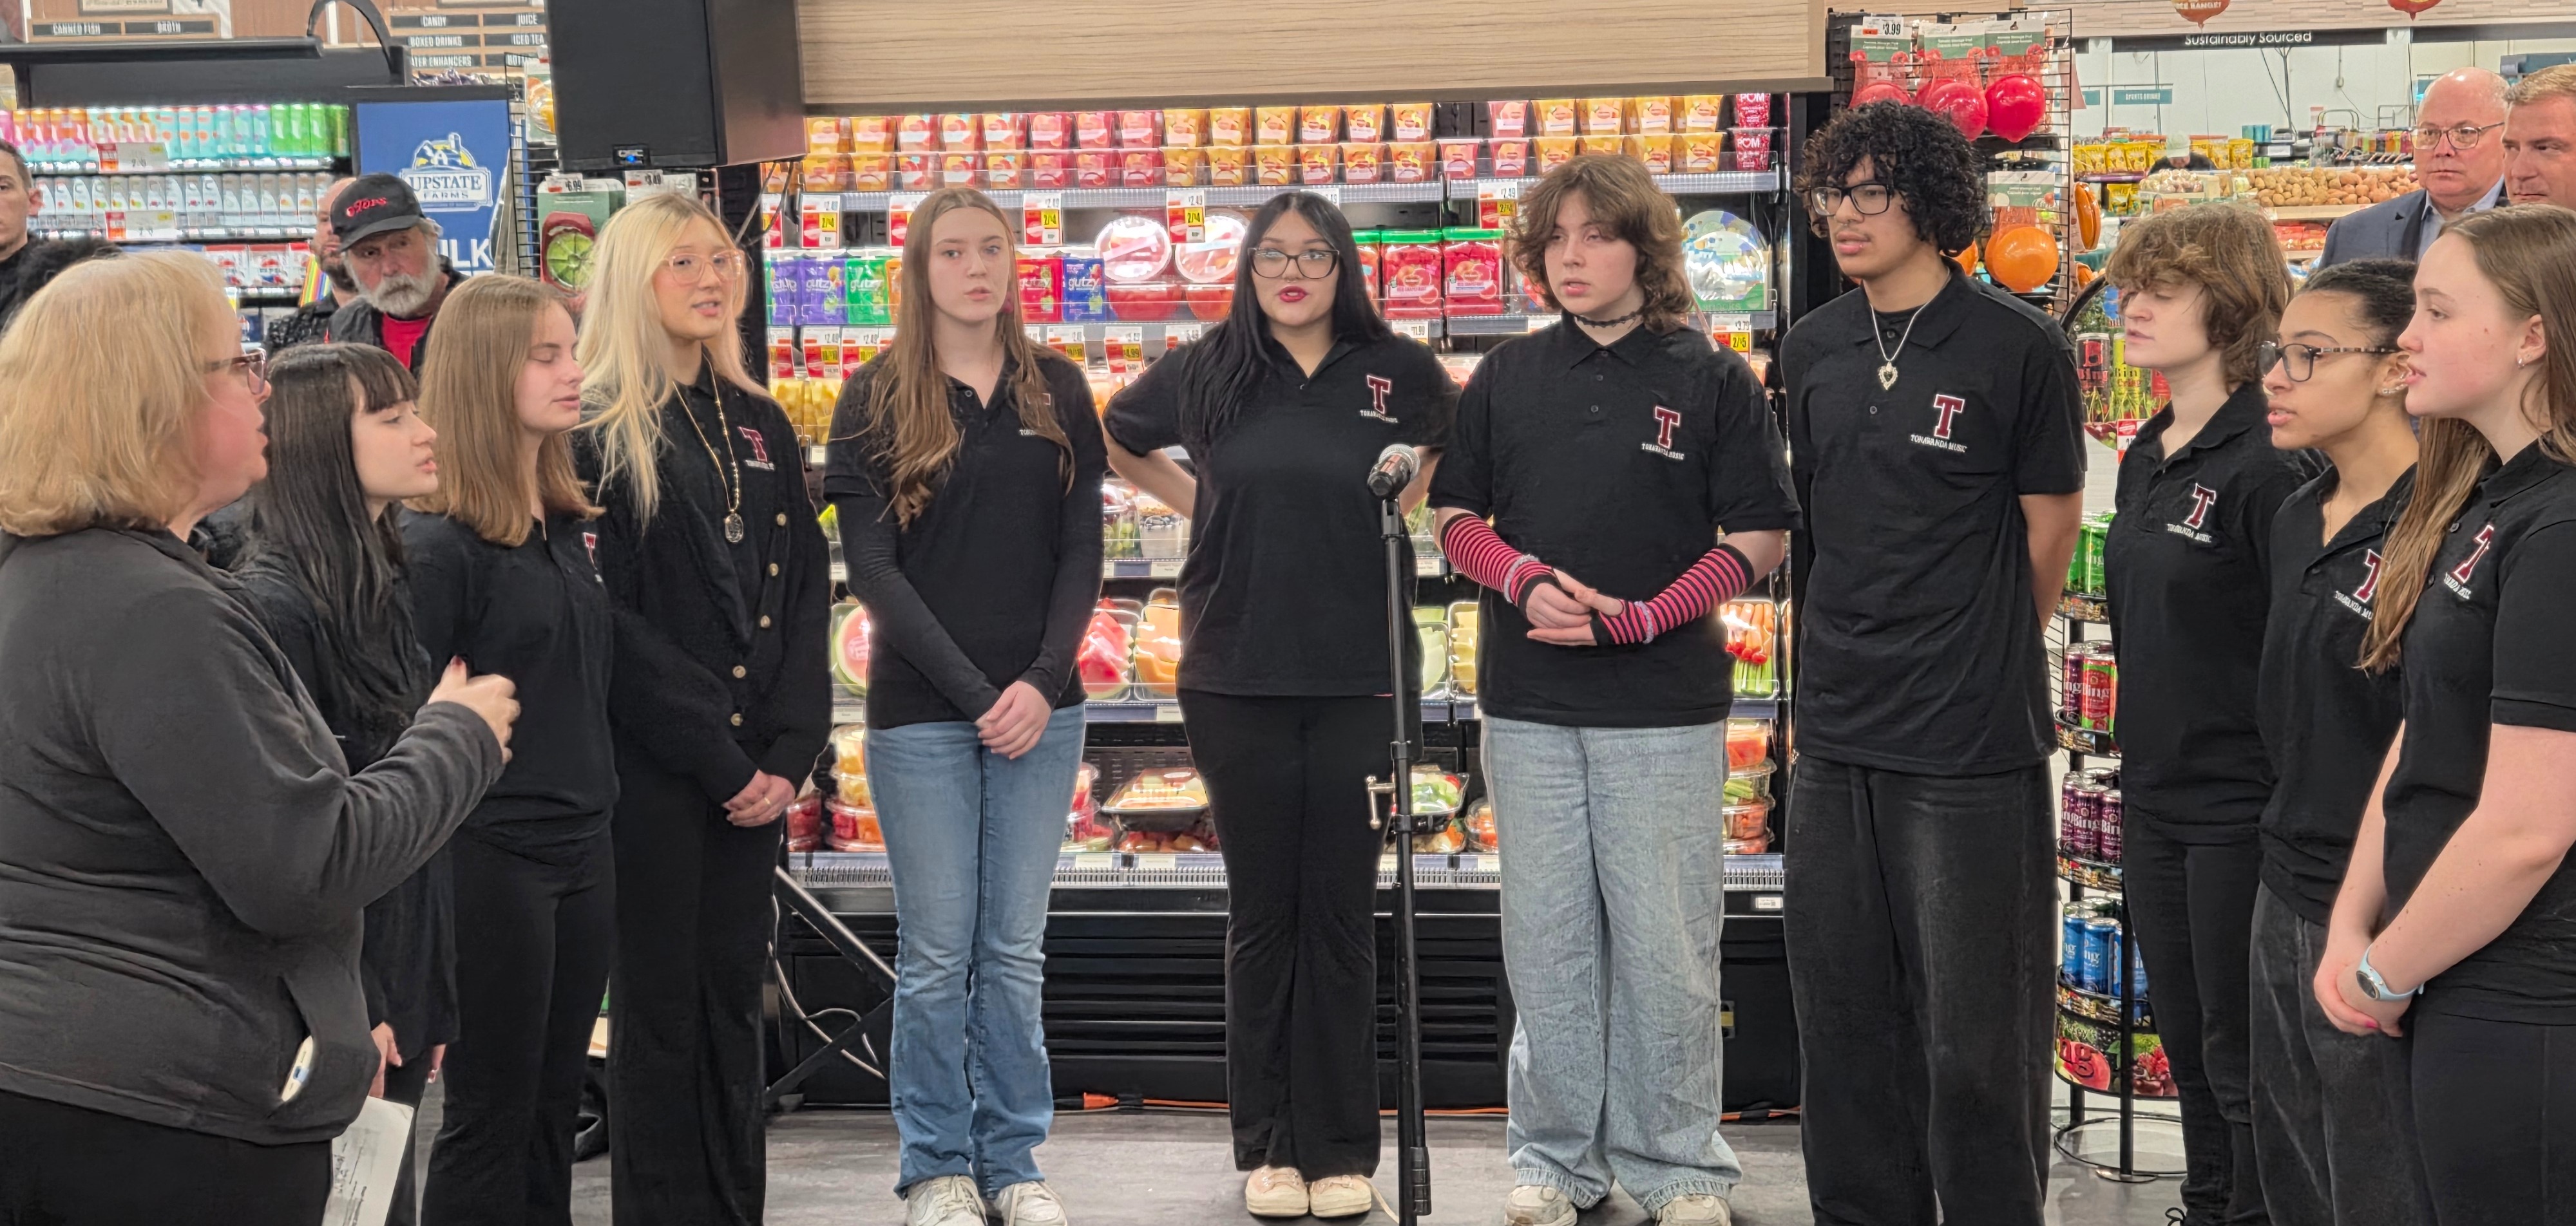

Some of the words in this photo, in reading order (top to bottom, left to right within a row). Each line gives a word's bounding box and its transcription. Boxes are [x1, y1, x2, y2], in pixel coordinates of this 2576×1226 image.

[423, 16, 446, 26] CANDY
[519, 14, 537, 26] JUICE
[1883, 23, 1901, 36] $3.99
[410, 37, 434, 47] BOXED
[435, 35, 462, 46] DRINKS
[532, 33, 544, 44] TEA
[2185, 34, 2255, 45] Sustainably
[2259, 32, 2312, 43] Sourced
[411, 56, 427, 66] ATER
[430, 55, 472, 66] ENHANCERS
[1737, 137, 1760, 148] POM
[409, 175, 482, 191] UPSTATE
[437, 238, 493, 268] ILK
[1069, 277, 1099, 291] gutzy
[1733, 337, 1746, 348] 2/$5
[1367, 375, 1391, 414] T
[1934, 393, 1965, 439] T
[1655, 406, 1681, 449] T
[738, 426, 768, 462] T
[1911, 434, 1947, 449] TONAWANDA
[2184, 482, 2217, 529] T
[2452, 524, 2494, 583] T
[2074, 813, 2101, 832] Bing
[2101, 819, 2121, 835] Bin
